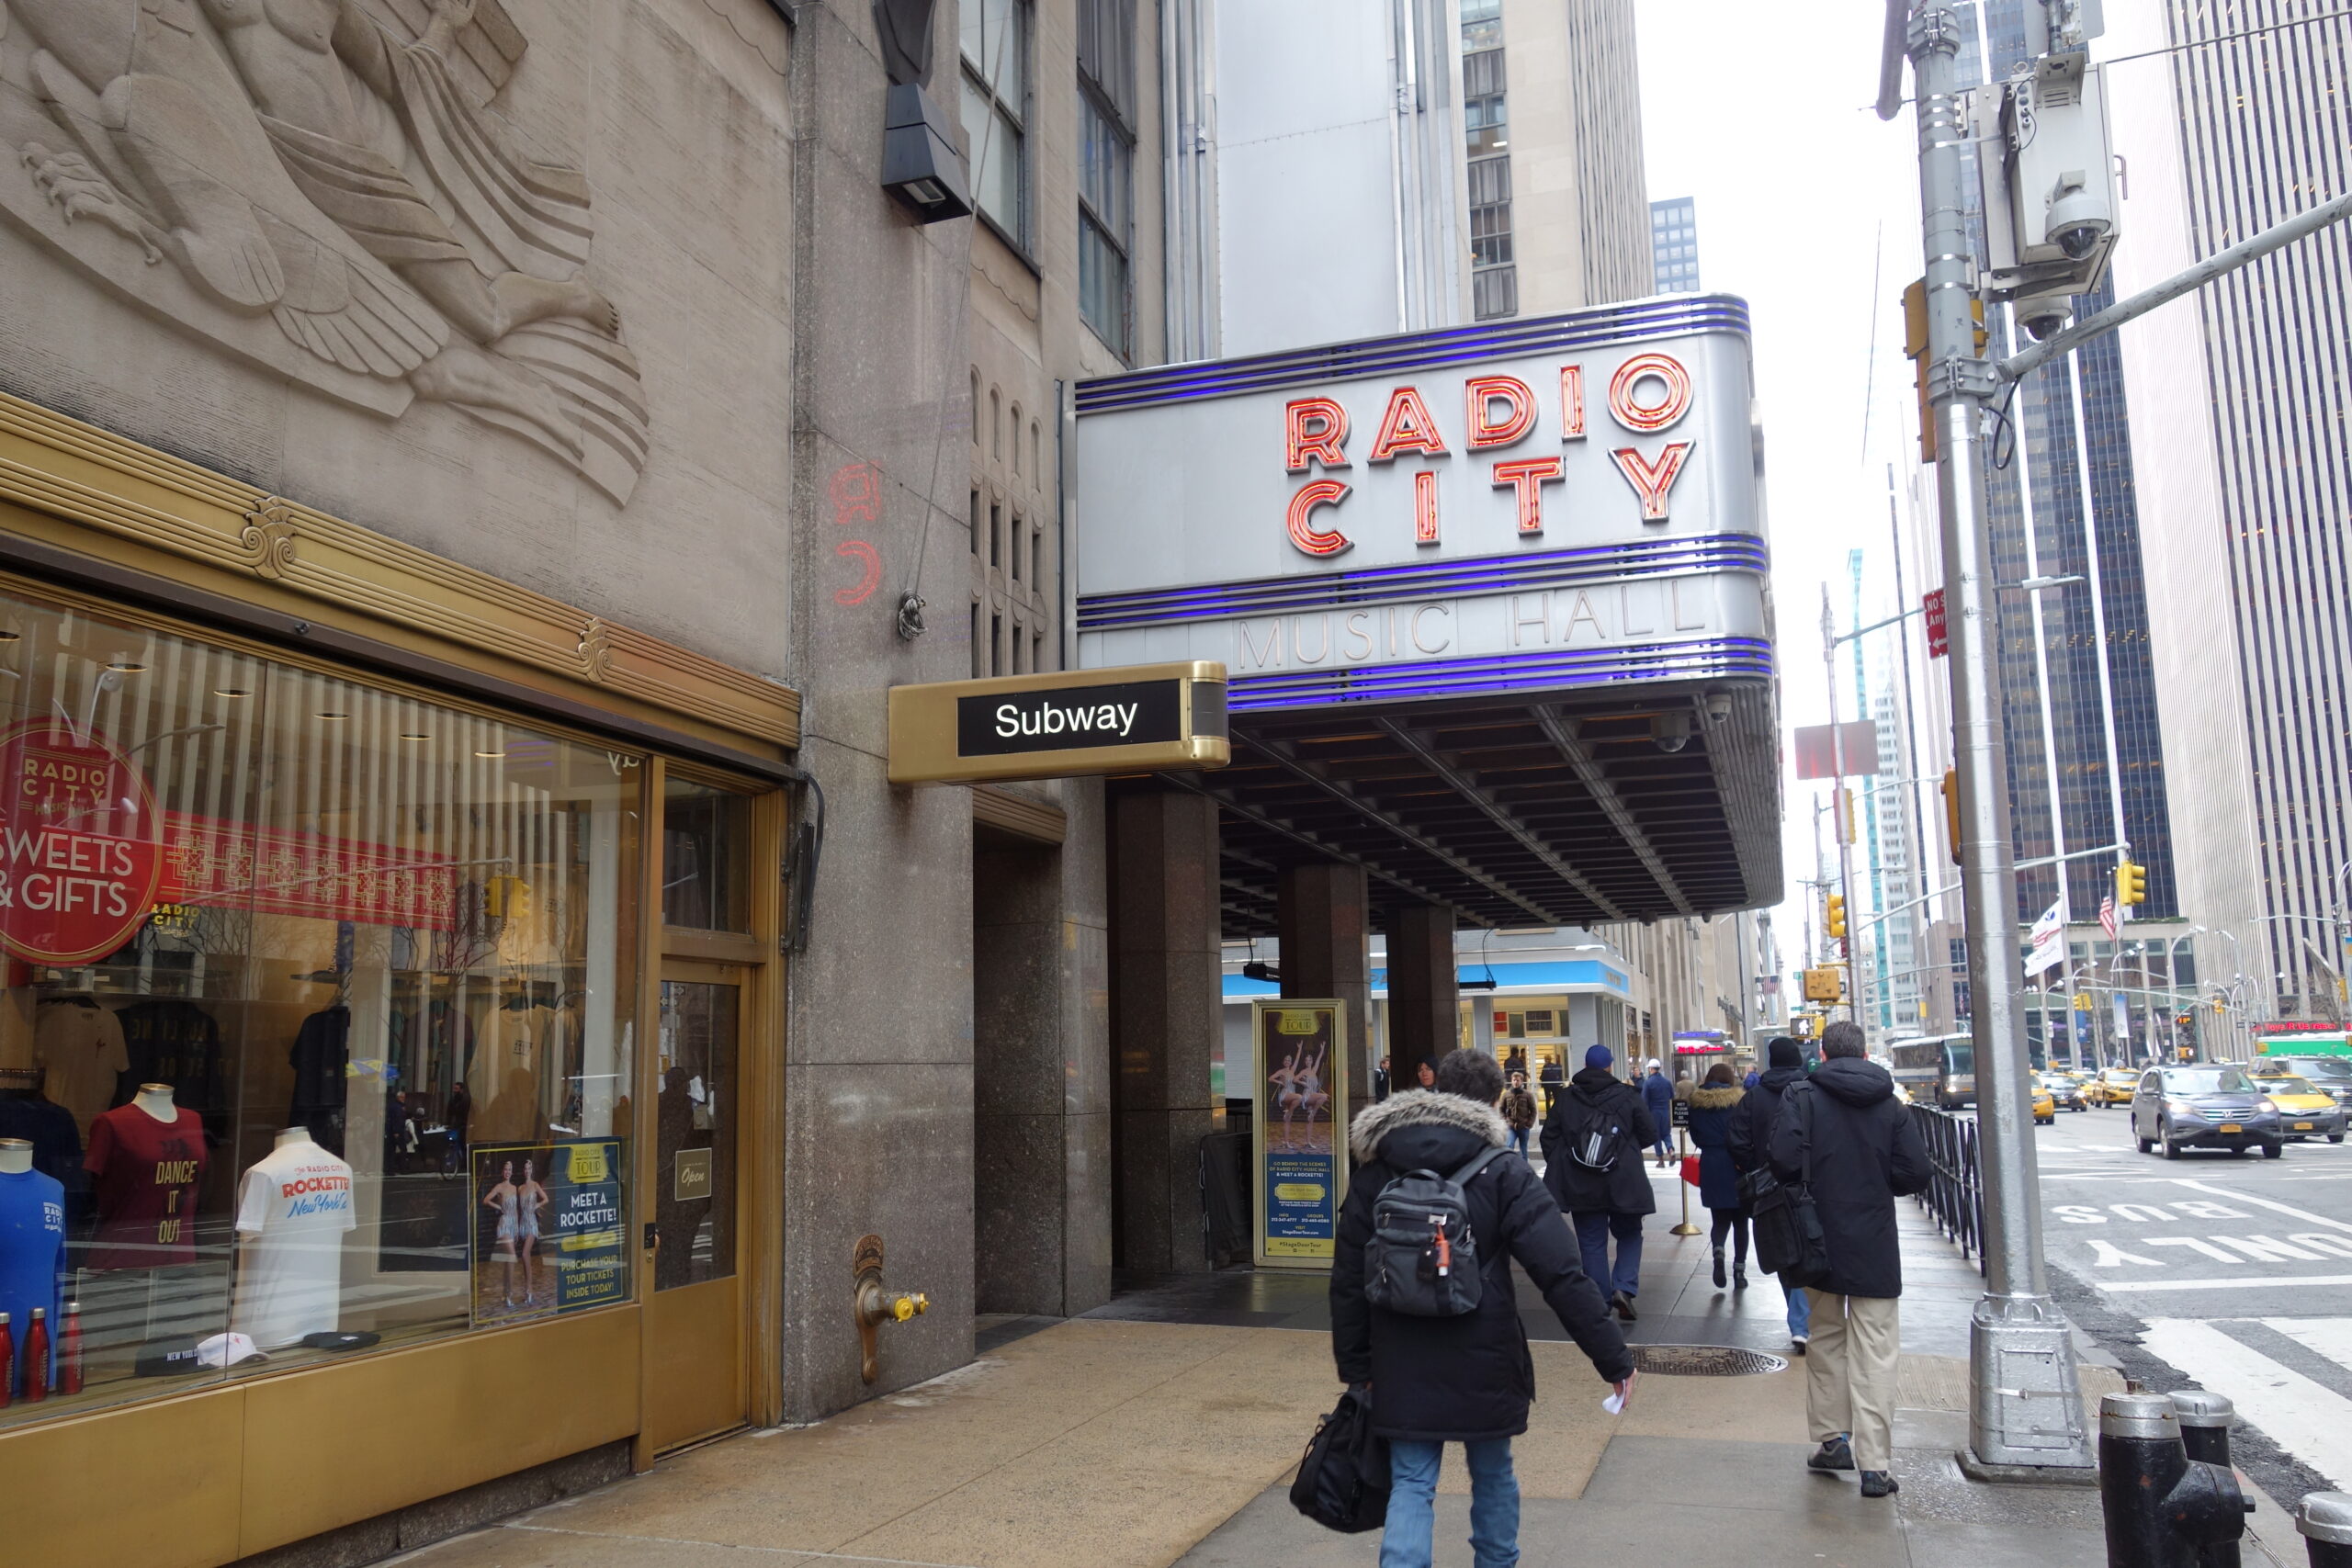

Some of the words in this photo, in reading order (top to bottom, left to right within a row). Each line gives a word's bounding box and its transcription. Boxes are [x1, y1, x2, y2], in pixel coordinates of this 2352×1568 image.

[1285, 352, 1694, 475] RADIO
[1285, 438, 1697, 558] CITY
[1927, 598, 1939, 612] NO
[1238, 603, 1450, 669] MUSIC
[1512, 581, 1706, 646] HALL
[995, 702, 1138, 737] Subway
[24, 758, 106, 786] RADIO
[23, 779, 105, 805] CITY
[0, 826, 133, 876] WEETS
[21, 874, 128, 917] GIFTS
[151, 903, 200, 917] RADIO
[153, 914, 195, 928] CITY
[1285, 1021, 1312, 1030] TOUR
[155, 1161, 198, 1184] DANCE
[306, 1165, 330, 1173] RADIO
[576, 1160, 601, 1175] TOUR
[681, 1168, 705, 1187] Open
[168, 1190, 179, 1213] IT
[287, 1199, 317, 1219] New
[571, 1193, 598, 1208] MEET
[600, 1192, 606, 1205] A
[560, 1208, 617, 1227] ROCKETTE!
[2050, 1201, 2255, 1224] BUS
[158, 1219, 180, 1244] OUT
[560, 1258, 598, 1271] PURCHASE
[599, 1255, 617, 1267] YOUR
[566, 1274, 587, 1285] TOUR
[587, 1269, 615, 1283] TICKETS
[566, 1285, 590, 1299] INSIDE
[591, 1282, 615, 1294] TODAY!
[167, 1351, 181, 1361] NEW
